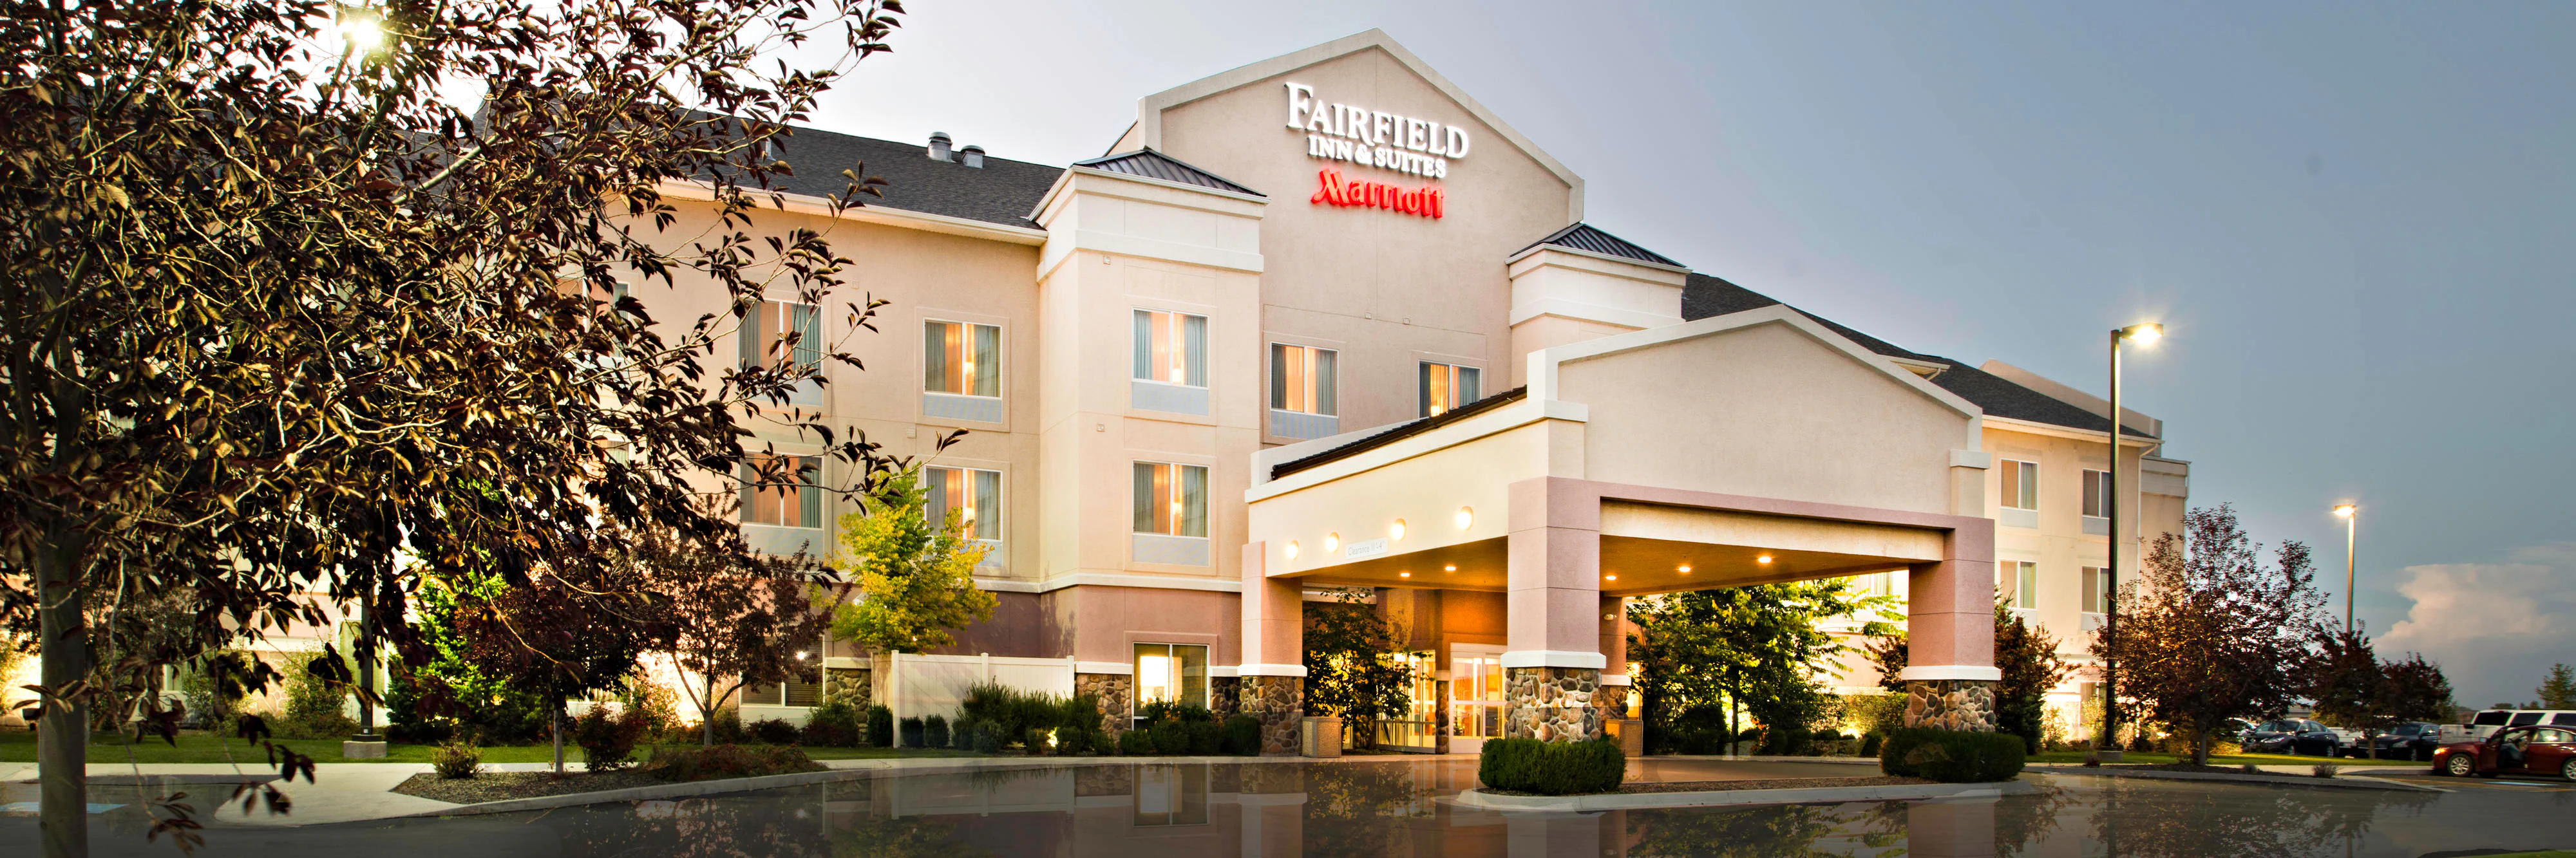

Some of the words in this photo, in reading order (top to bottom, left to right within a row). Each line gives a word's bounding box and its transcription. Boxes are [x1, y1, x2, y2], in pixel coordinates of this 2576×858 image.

[1284, 82, 1469, 159] FAIRFIELD
[1307, 135, 1352, 161] INN
[1354, 144, 1373, 165] &
[1373, 147, 1447, 179] SUITES
[1311, 168, 1444, 218] Marriott
[1348, 546, 1370, 555] Clearance
